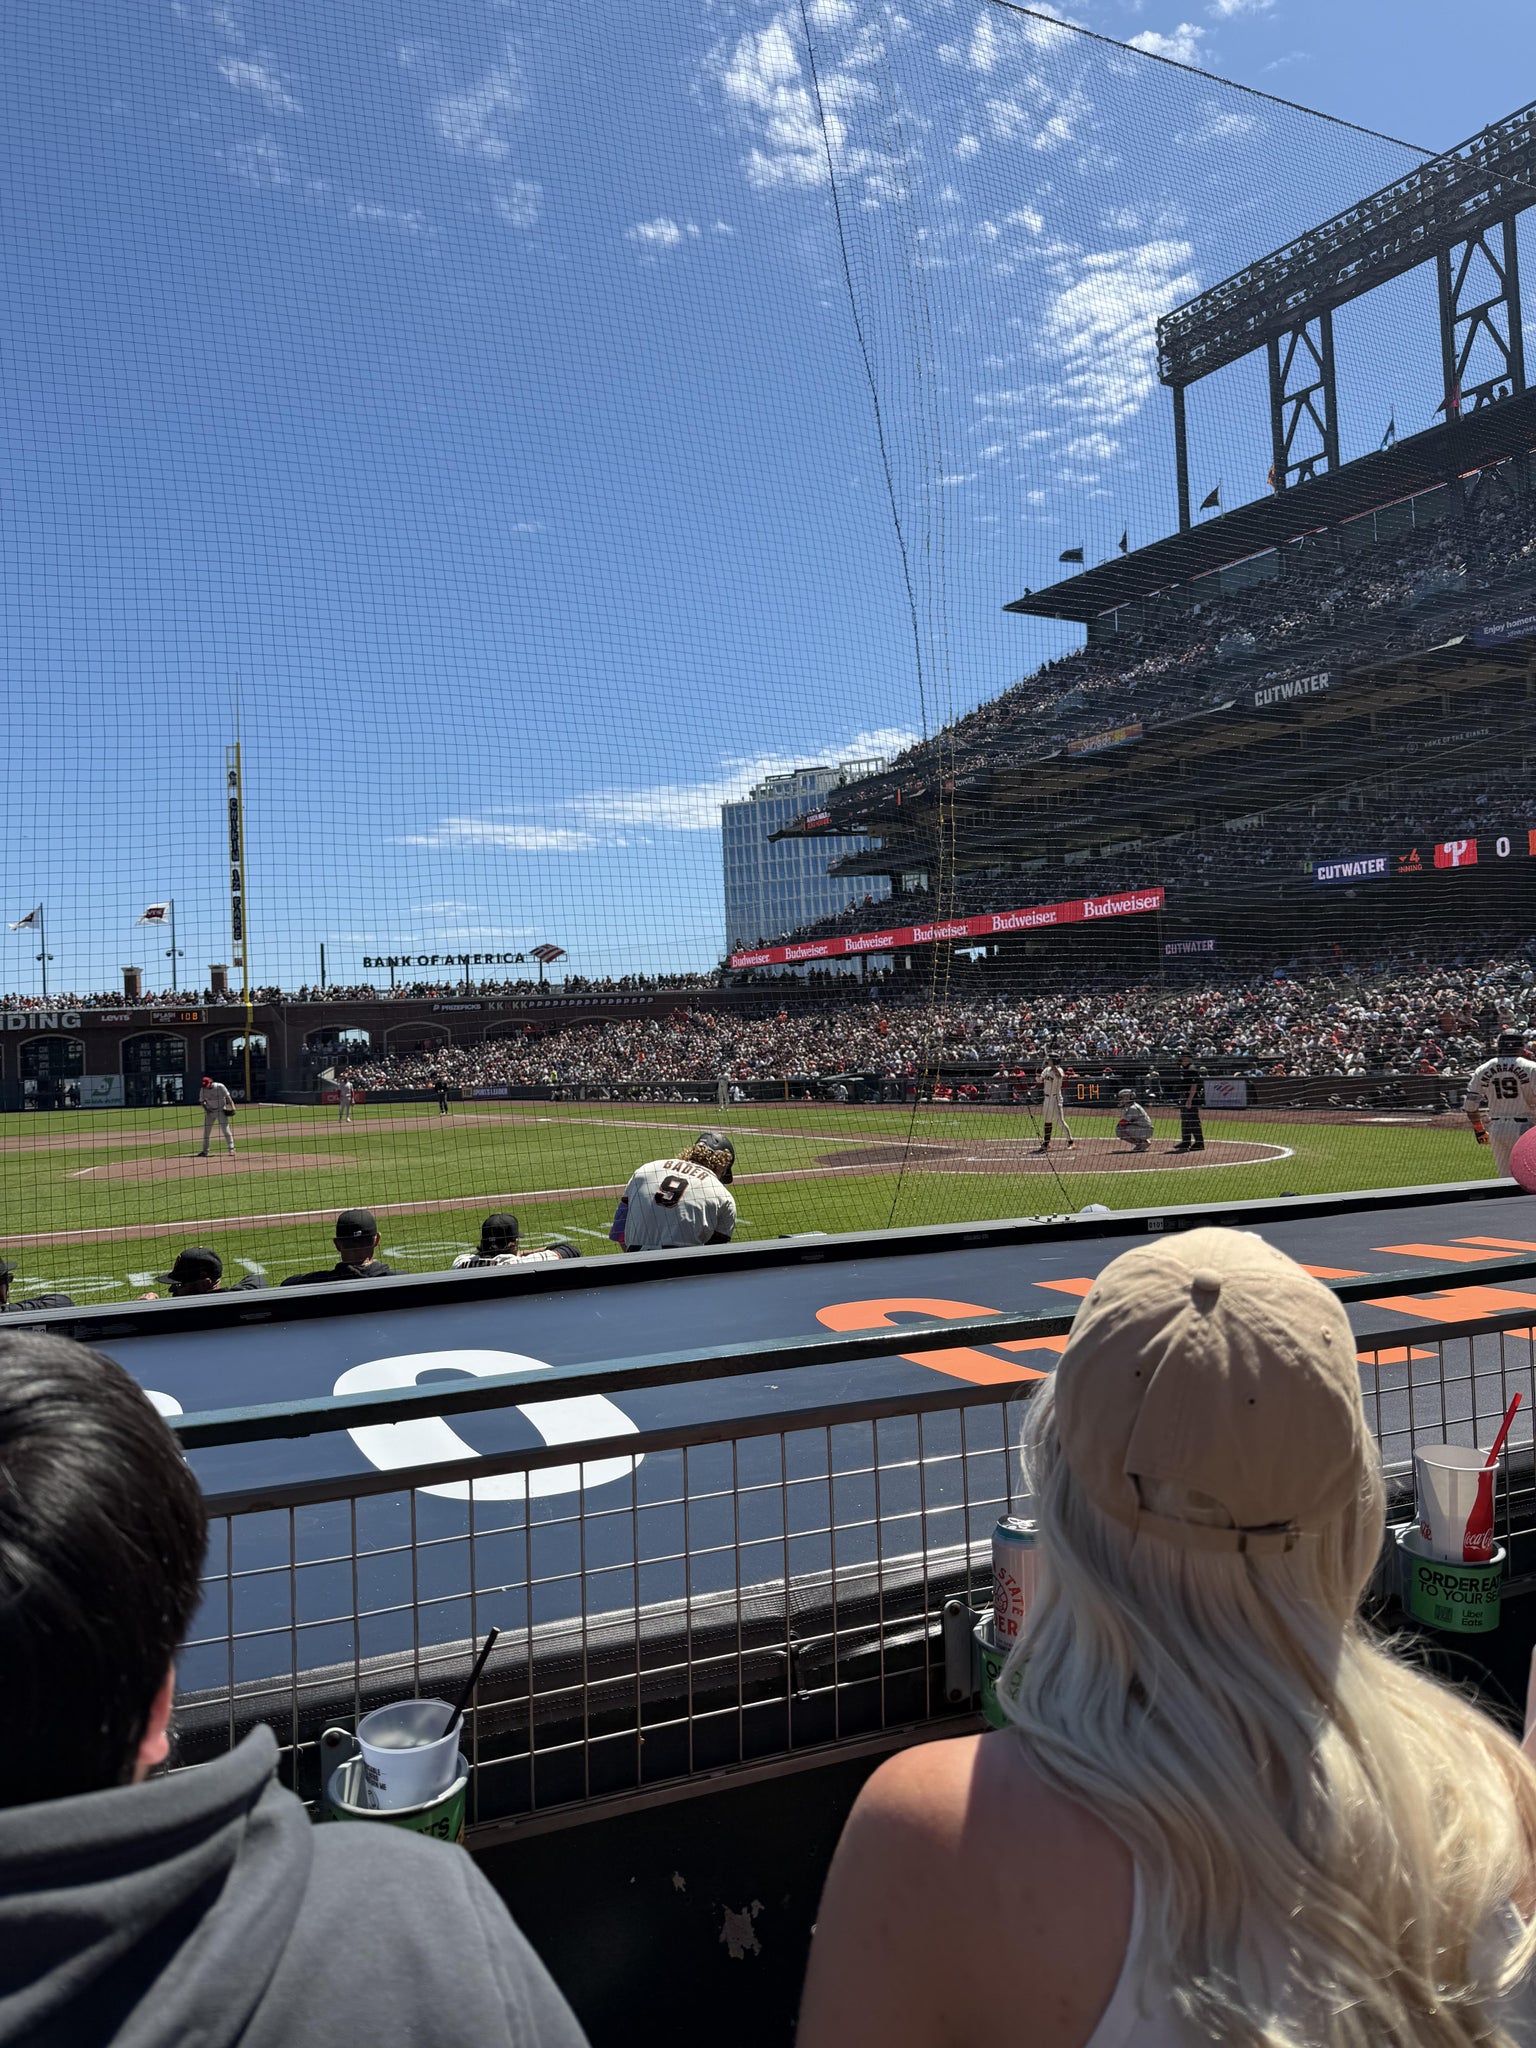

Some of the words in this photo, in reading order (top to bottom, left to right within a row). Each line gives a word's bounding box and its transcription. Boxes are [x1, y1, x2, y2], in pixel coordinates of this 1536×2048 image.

[1483, 623, 1505, 635] Enjoy
[1255, 673, 1329, 707] CUTWATER
[1409, 848, 1421, 864] 4
[1496, 837, 1511, 857] 0
[1318, 858, 1385, 881] CUTWATER
[1165, 940, 1215, 955] CUTWATER
[363, 956, 411, 968] BANK
[417, 955, 439, 966] OF
[445, 952, 525, 966] AMERICA
[1492, 1076, 1519, 1099] 19
[663, 1160, 709, 1181] BADER
[654, 1175, 689, 1208] 9
[1418, 1566, 1480, 1592] ORDER
[999, 1567, 1025, 1618] STATE
[1419, 1581, 1439, 1597] TO
[1443, 1589, 1483, 1605] YOUR
[1461, 1618, 1483, 1627] Eats
[1462, 1609, 1483, 1618] Uber
